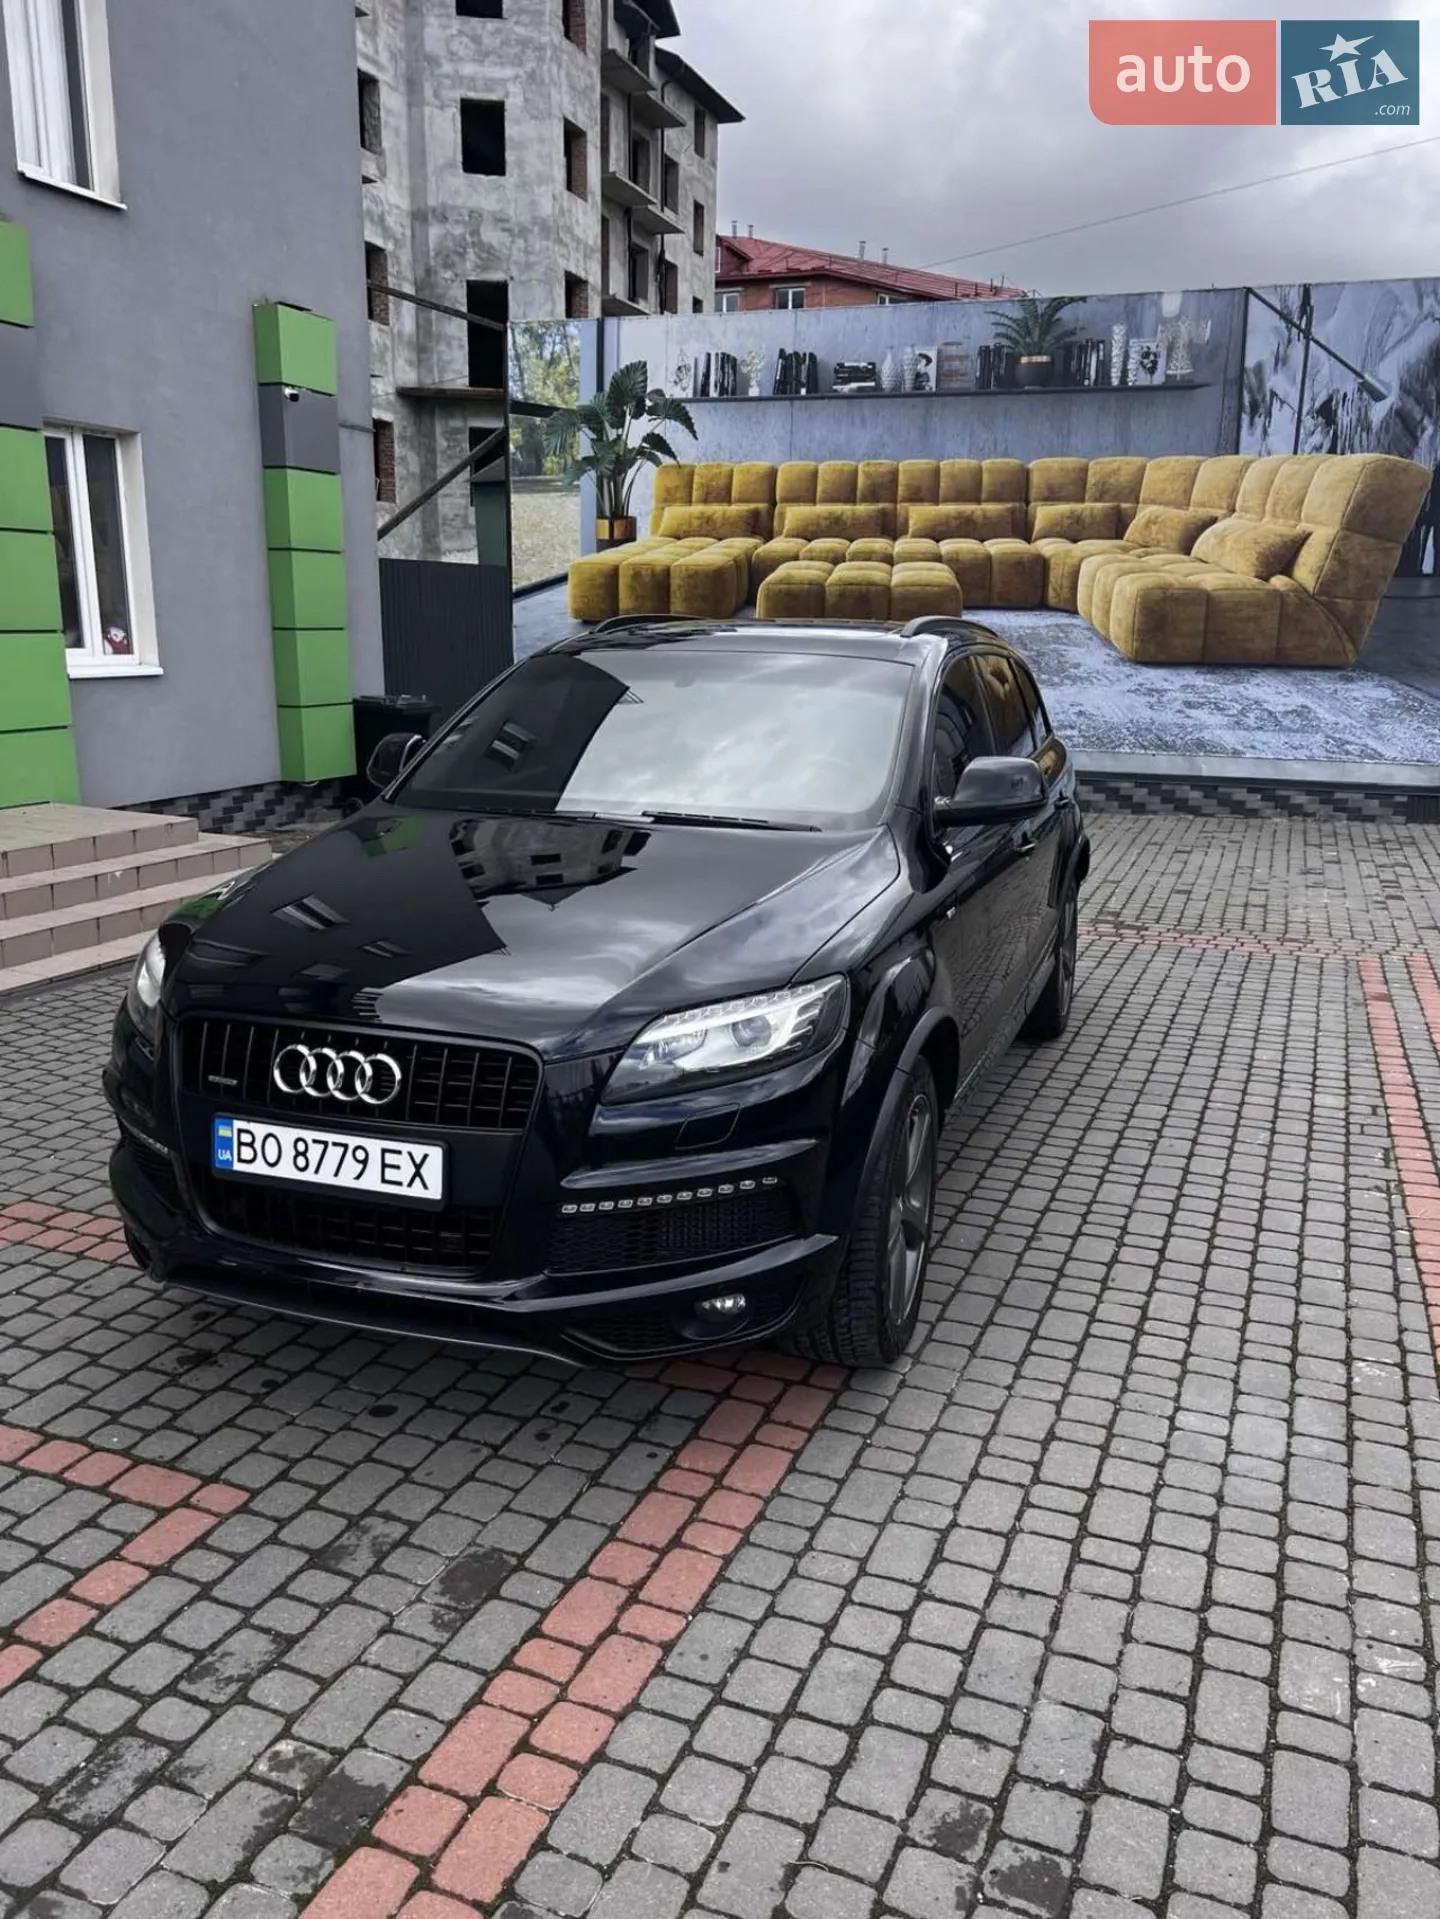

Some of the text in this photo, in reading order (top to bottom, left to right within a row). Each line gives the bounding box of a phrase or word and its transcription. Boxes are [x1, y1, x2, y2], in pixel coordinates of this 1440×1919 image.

[218, 1149, 232, 1161] UA
[237, 1128, 430, 1190] BO 8779 EX
